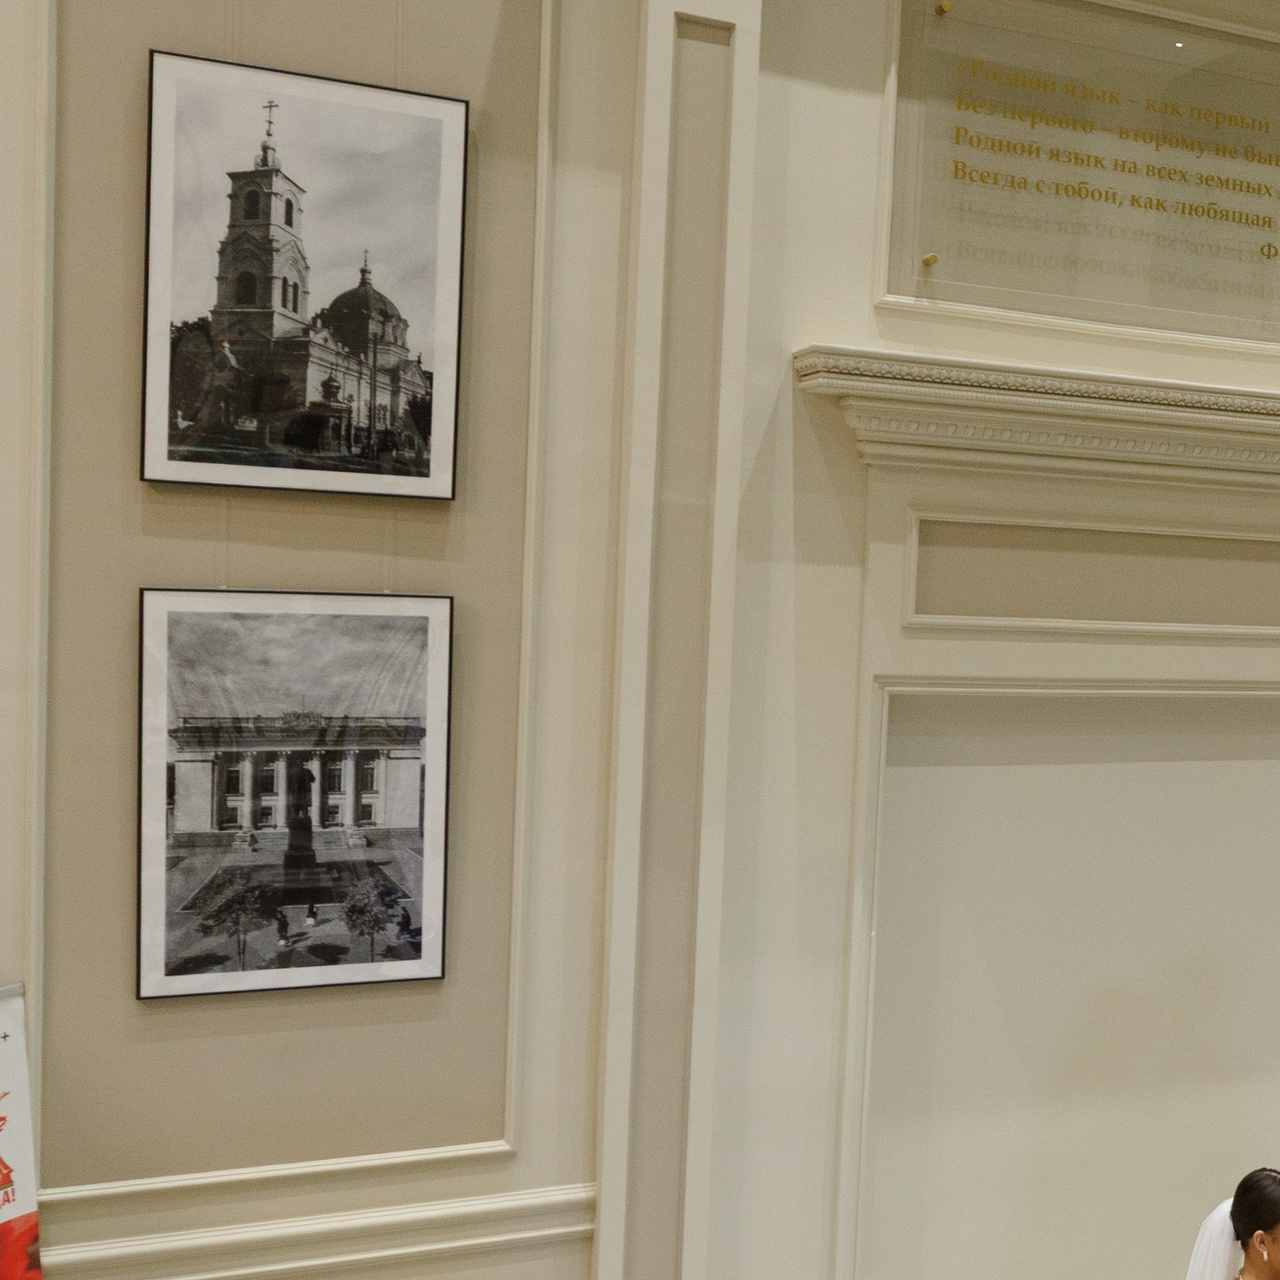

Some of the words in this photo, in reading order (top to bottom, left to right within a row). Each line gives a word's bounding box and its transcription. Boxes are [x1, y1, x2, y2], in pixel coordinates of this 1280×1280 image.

[956, 90, 995, 116] Без
[1003, 102, 1094, 134] первого
[1119, 126, 1206, 158] второму
[1214, 143, 1240, 159] не
[1064, 81, 1121, 105] язык
[1145, 99, 1182, 117] как
[1189, 107, 1270, 134] первый
[953, 159, 1029, 191] Всегда
[1034, 178, 1046, 194] с
[1051, 180, 1124, 208] тобой,
[1130, 194, 1168, 212] как
[1173, 201, 1274, 229] любящая
[954, 125, 1042, 159] Родной
[1049, 146, 1106, 170] язык
[1113, 157, 1138, 174] на
[1145, 163, 1190, 183] всех
[1194, 172, 1273, 197] земных
